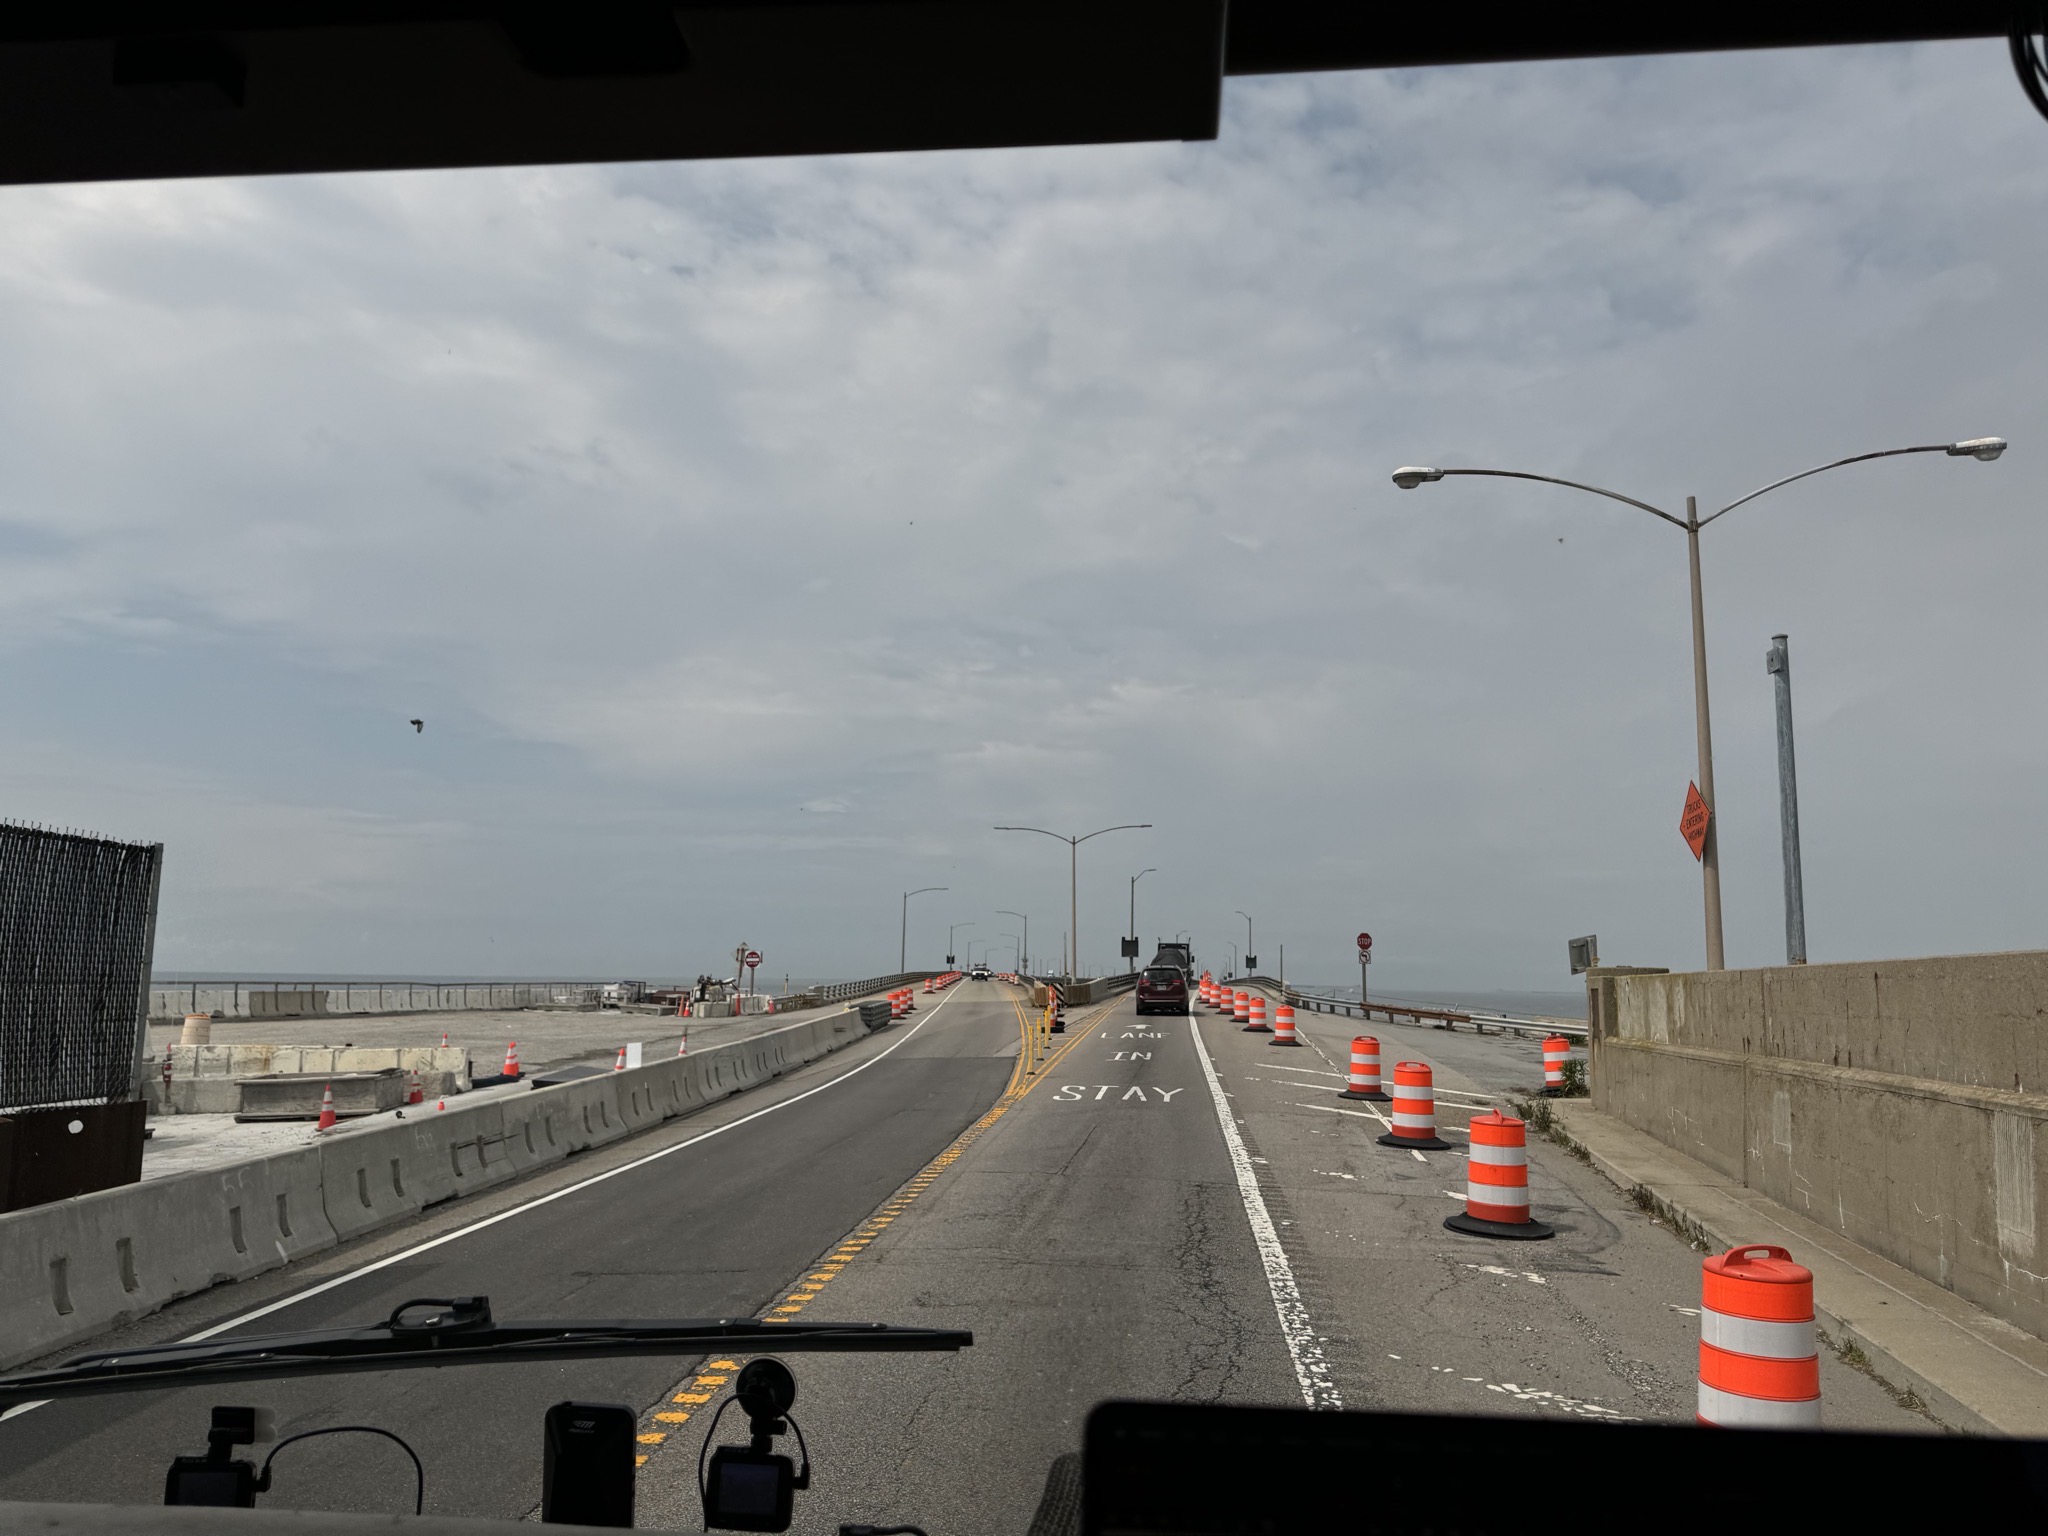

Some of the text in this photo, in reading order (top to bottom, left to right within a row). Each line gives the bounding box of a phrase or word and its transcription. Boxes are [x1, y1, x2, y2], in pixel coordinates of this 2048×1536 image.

[1358, 937, 1371, 945] STOP
[1105, 1051, 1153, 1061] IN
[1052, 1084, 1185, 1103] STAY
